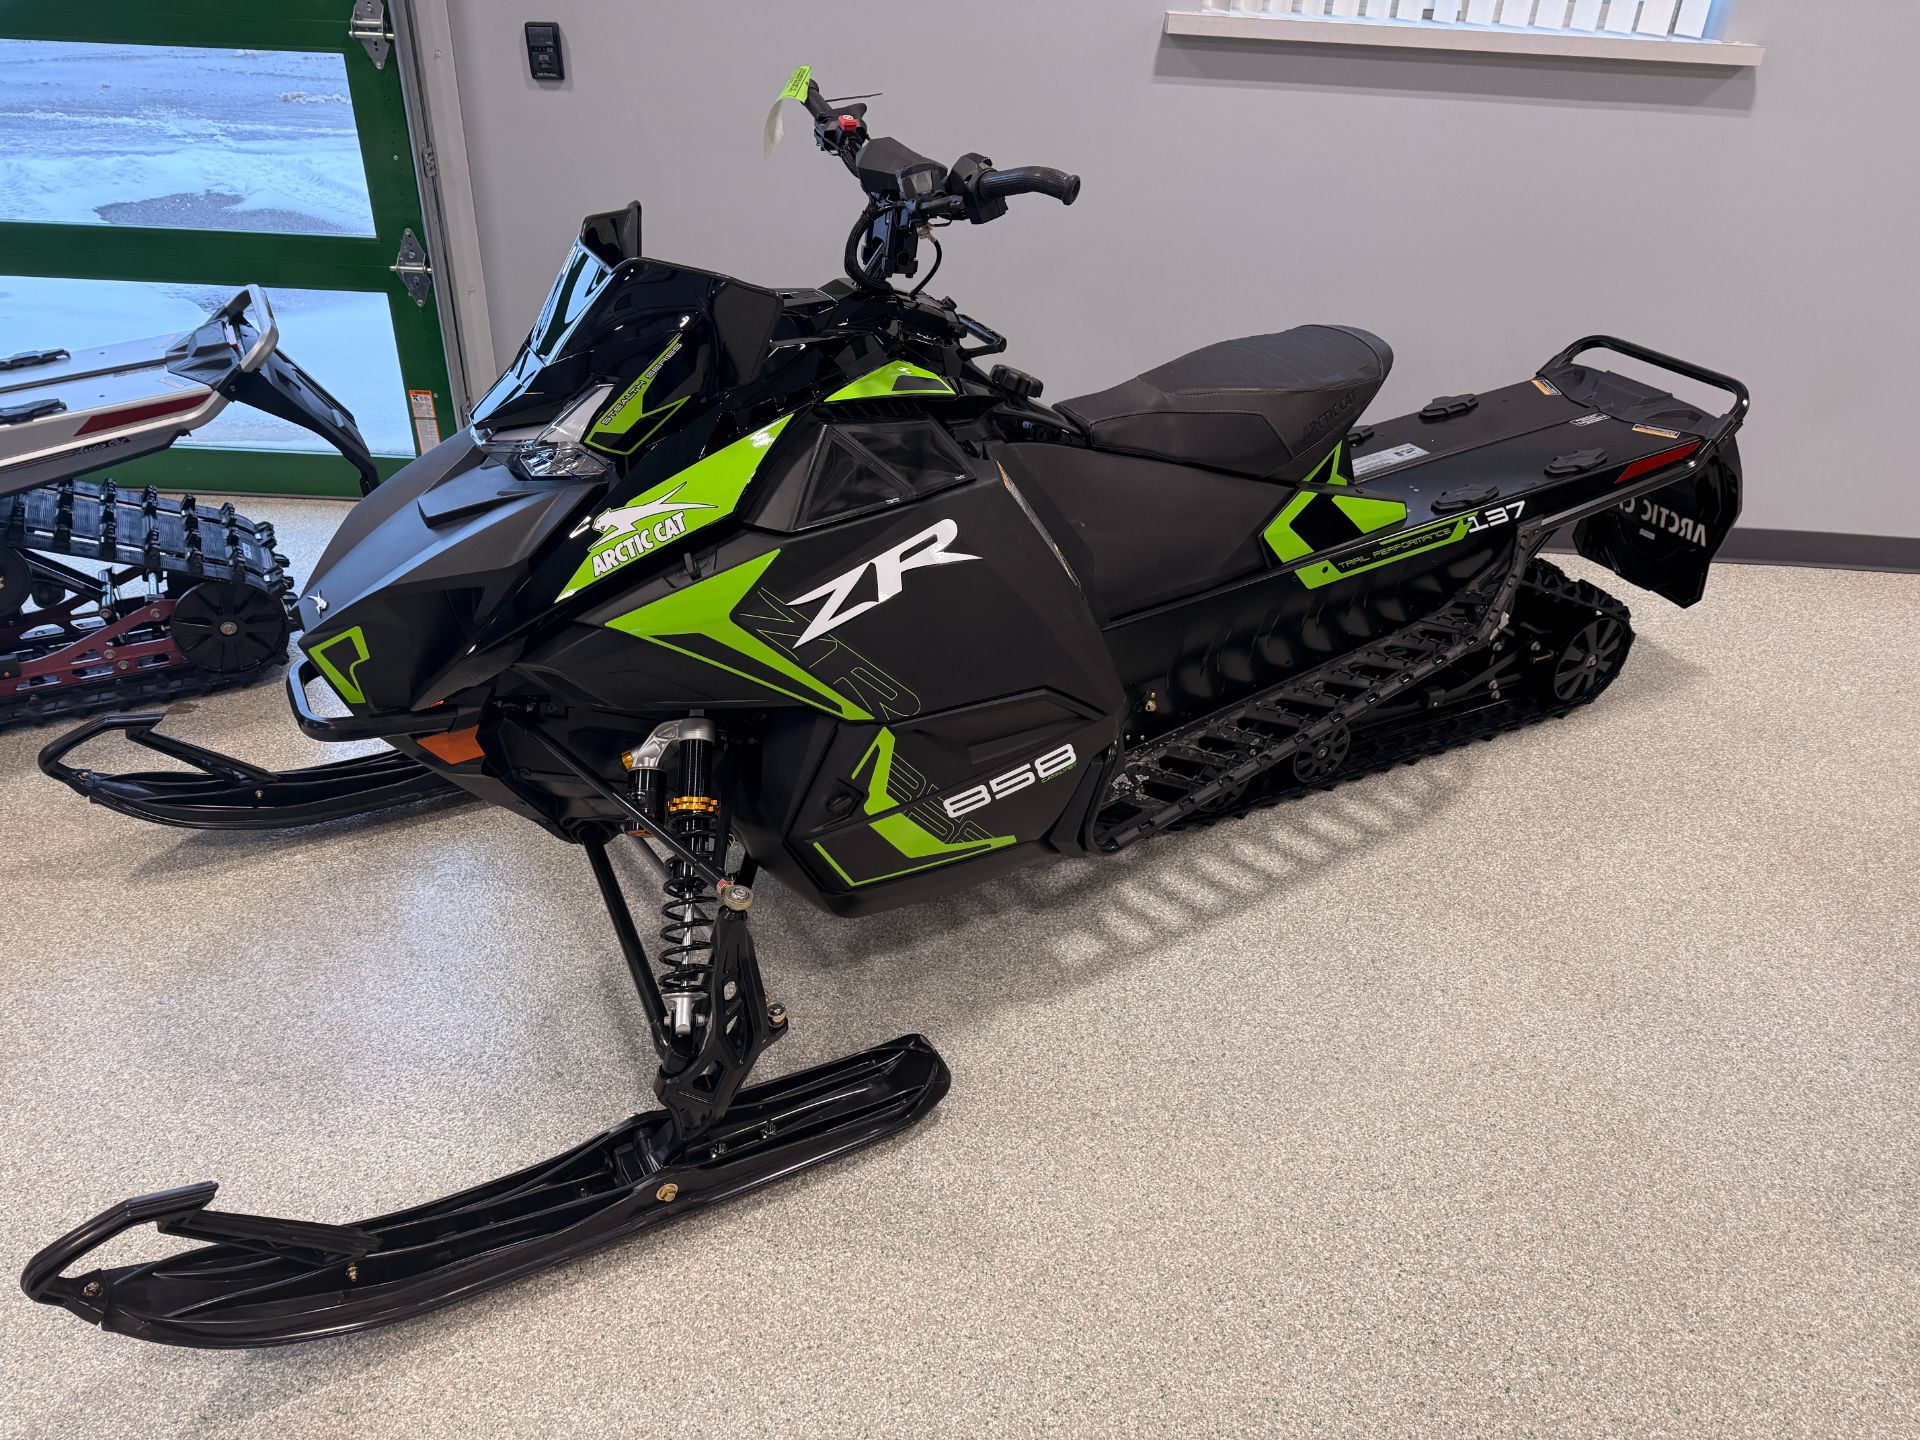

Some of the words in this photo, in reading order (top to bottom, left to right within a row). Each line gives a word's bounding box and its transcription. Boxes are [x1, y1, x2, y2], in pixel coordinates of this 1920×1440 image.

[601, 380, 647, 425] STEALTH
[645, 342, 683, 379] SERIES
[592, 529, 655, 577] ARCTIC
[653, 511, 687, 542] CAT
[1338, 555, 1371, 569] TRAIL
[1372, 528, 1452, 558] PERFORMANCE
[1467, 500, 1526, 534] 137
[785, 518, 984, 649] ZR
[943, 743, 1077, 818] 858
